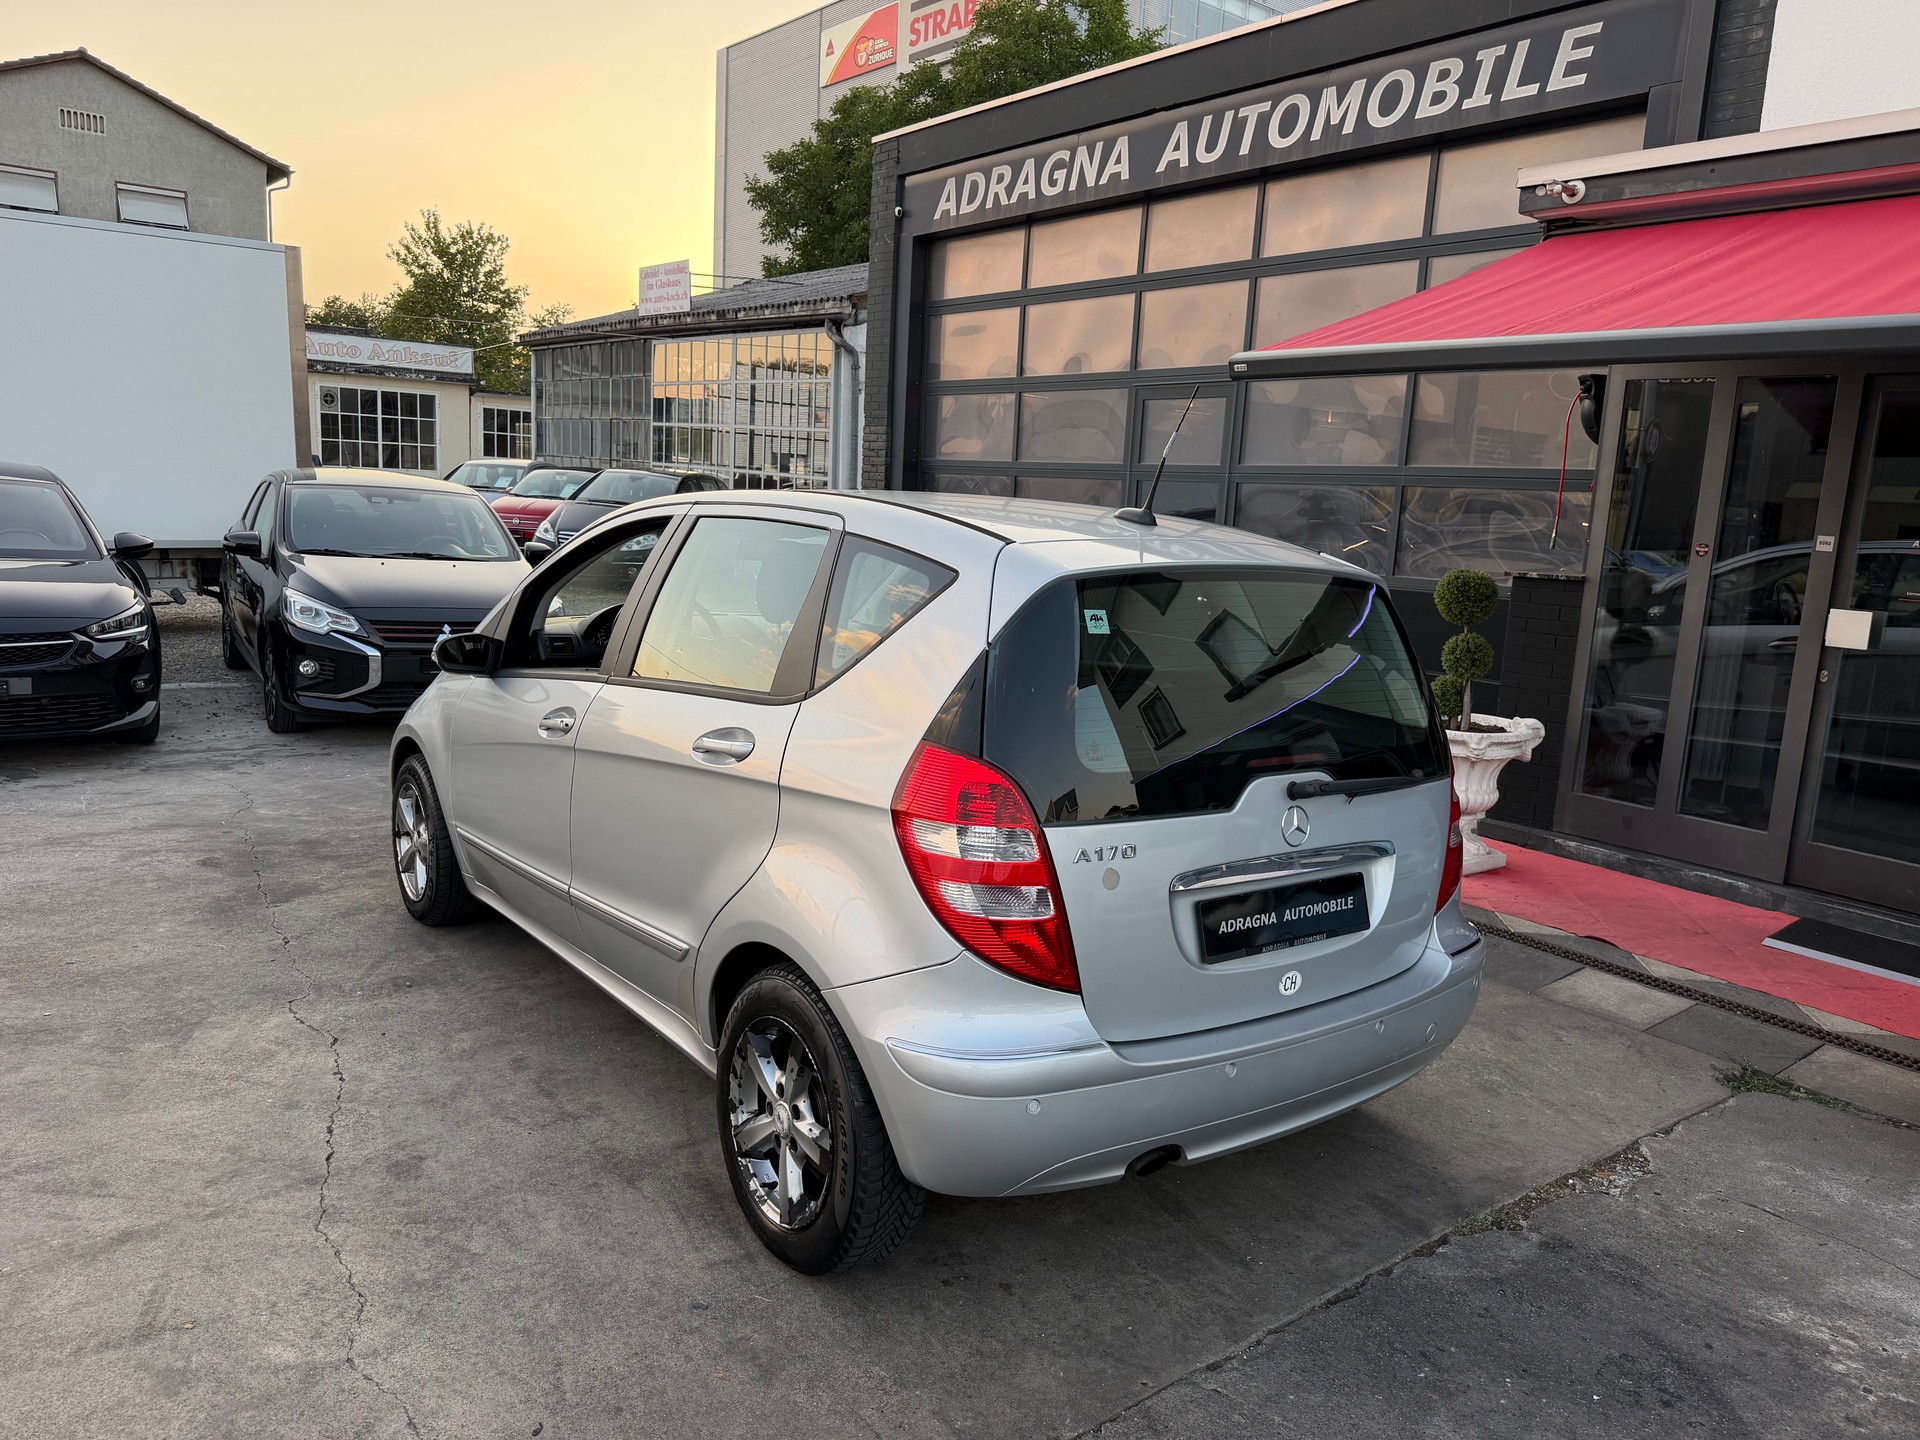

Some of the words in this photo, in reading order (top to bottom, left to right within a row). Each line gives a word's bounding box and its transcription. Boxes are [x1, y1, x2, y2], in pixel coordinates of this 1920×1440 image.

[909, 0, 995, 47] STRAB
[932, 136, 1131, 220] ADRAGNA
[1155, 21, 1604, 174] AUTOMOBILE
[305, 335, 362, 358] Auto
[367, 343, 459, 368] Ankauf
[1218, 911, 1277, 934] ADRAGNA
[1283, 895, 1355, 922] AUTOMOBILE
[1261, 941, 1291, 954] ADRAGNA
[1293, 933, 1327, 947] AUTOMOBILE
[1283, 974, 1298, 992] CH
